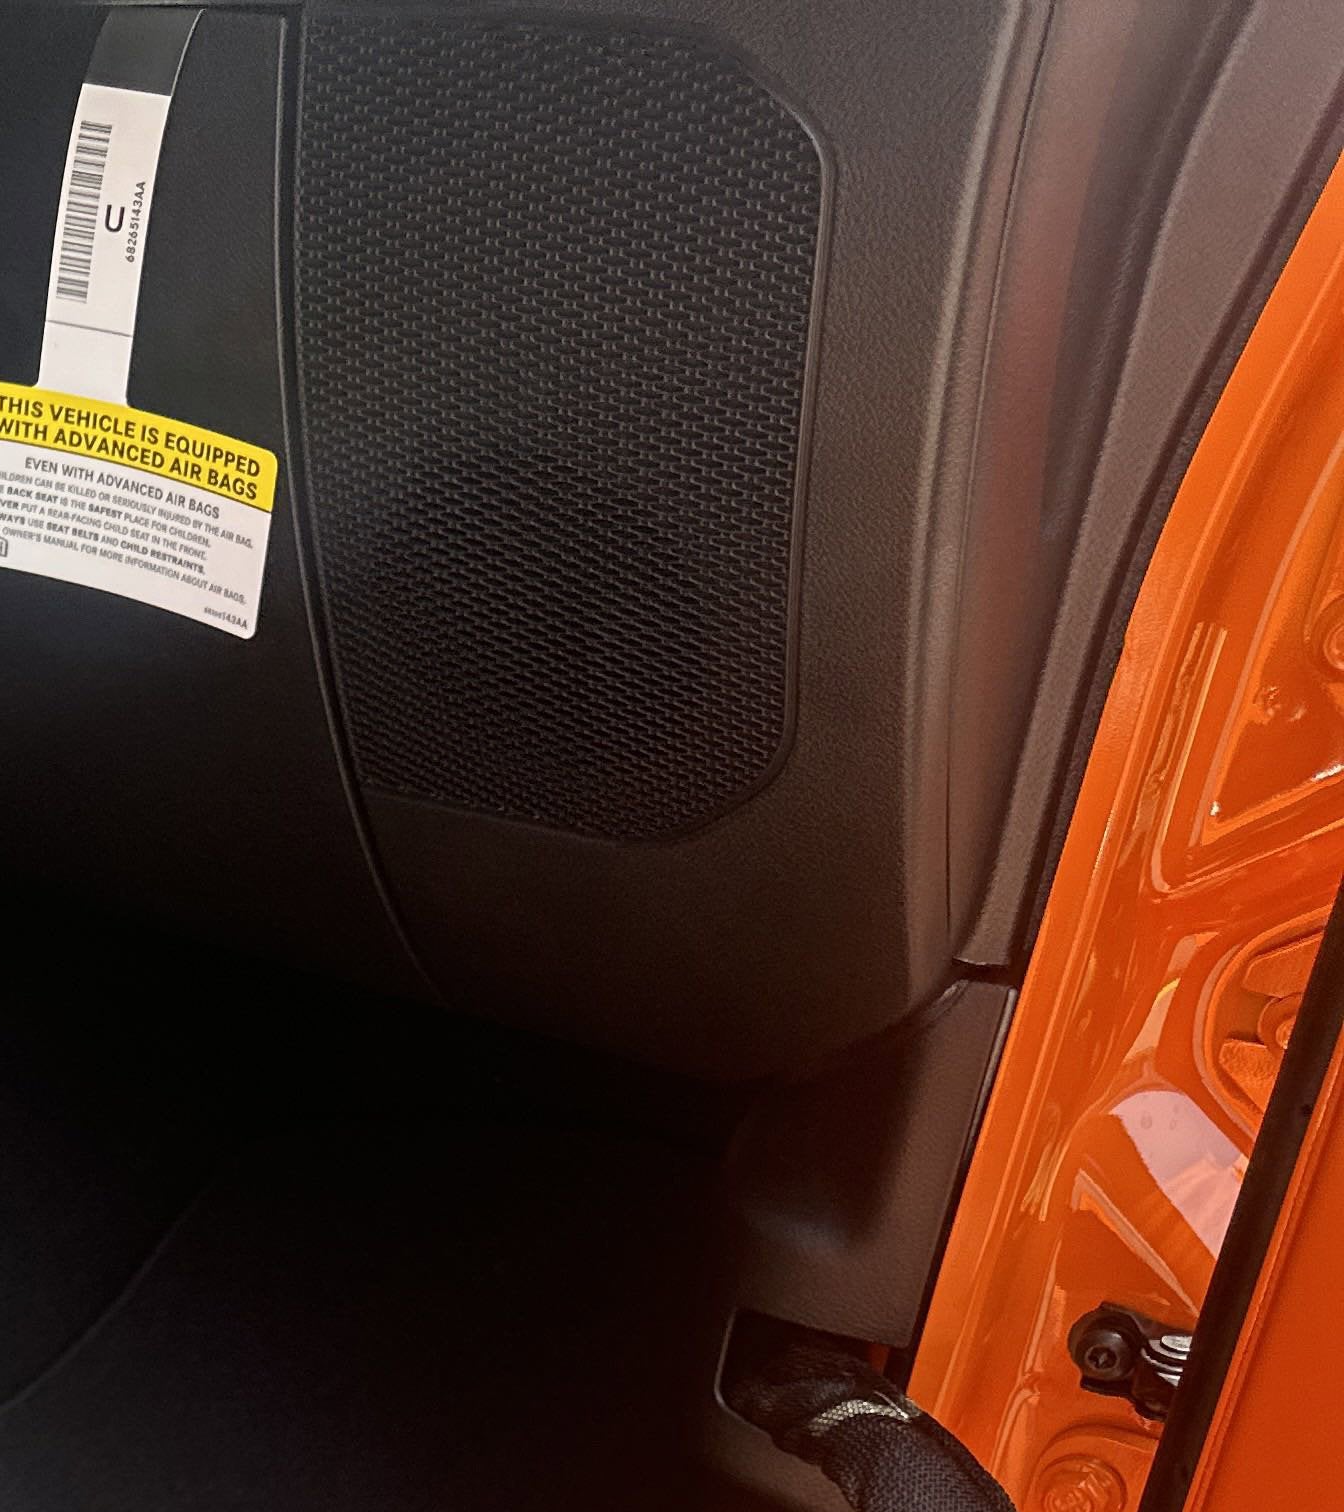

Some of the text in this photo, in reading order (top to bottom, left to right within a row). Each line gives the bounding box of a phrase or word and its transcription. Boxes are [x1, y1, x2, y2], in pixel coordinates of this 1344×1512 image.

[125, 182, 146, 263] 68265143AA
[50, 404, 135, 439] VEHICLE
[141, 425, 159, 445] IS
[164, 431, 261, 478] EQUIPPED
[54, 429, 164, 469] ADVANCED
[169, 457, 202, 481] AIR
[207, 469, 257, 500] BAGS
[7, 487, 32, 497] BACK
[35, 492, 58, 503] SEAT
[60, 498, 68, 506] IS
[70, 500, 86, 510] THE
[88, 503, 123, 520] SAFEST
[124, 514, 150, 527] PLACE
[152, 520, 167, 533] FOR
[169, 526, 211, 548] CHILDREN.
[25, 457, 220, 519] EVEN WITH ADVANCED AIR BAGS
[34, 478, 52, 488] CAN
[55, 482, 66, 492] BE
[68, 485, 96, 498] KILLED
[98, 492, 110, 502] OR
[112, 494, 157, 515] SERIOUSLY
[158, 508, 191, 526] INJURED
[193, 520, 202, 529] BY
[204, 524, 220, 536] THE
[220, 529, 234, 542] AIR
[236, 534, 253, 549] BAG.
[2, 526, 41, 542] OWNER'S
[43, 536, 78, 551] MANUAL
[80, 544, 97, 555] FOR
[99, 548, 123, 562] MORE
[125, 555, 180, 580] INFORMATION
[181, 574, 208, 589] ABOUT
[209, 584, 222, 594] AIR
[21, 503, 38, 513] PUT
[39, 507, 45, 516] A
[47, 508, 101, 528] REAR-FACING
[103, 521, 128, 536] CHILD
[130, 528, 150, 541] SEAT
[152, 535, 160, 544] IN
[163, 538, 177, 551] THE
[179, 544, 207, 560] FRONT.
[27, 518, 44, 528] USE
[46, 522, 70, 534] SEAT
[72, 528, 99, 541] BELTS
[101, 535, 118, 547] AND
[120, 540, 148, 555] CHILD
[150, 548, 205, 575] RESTRAINTS.
